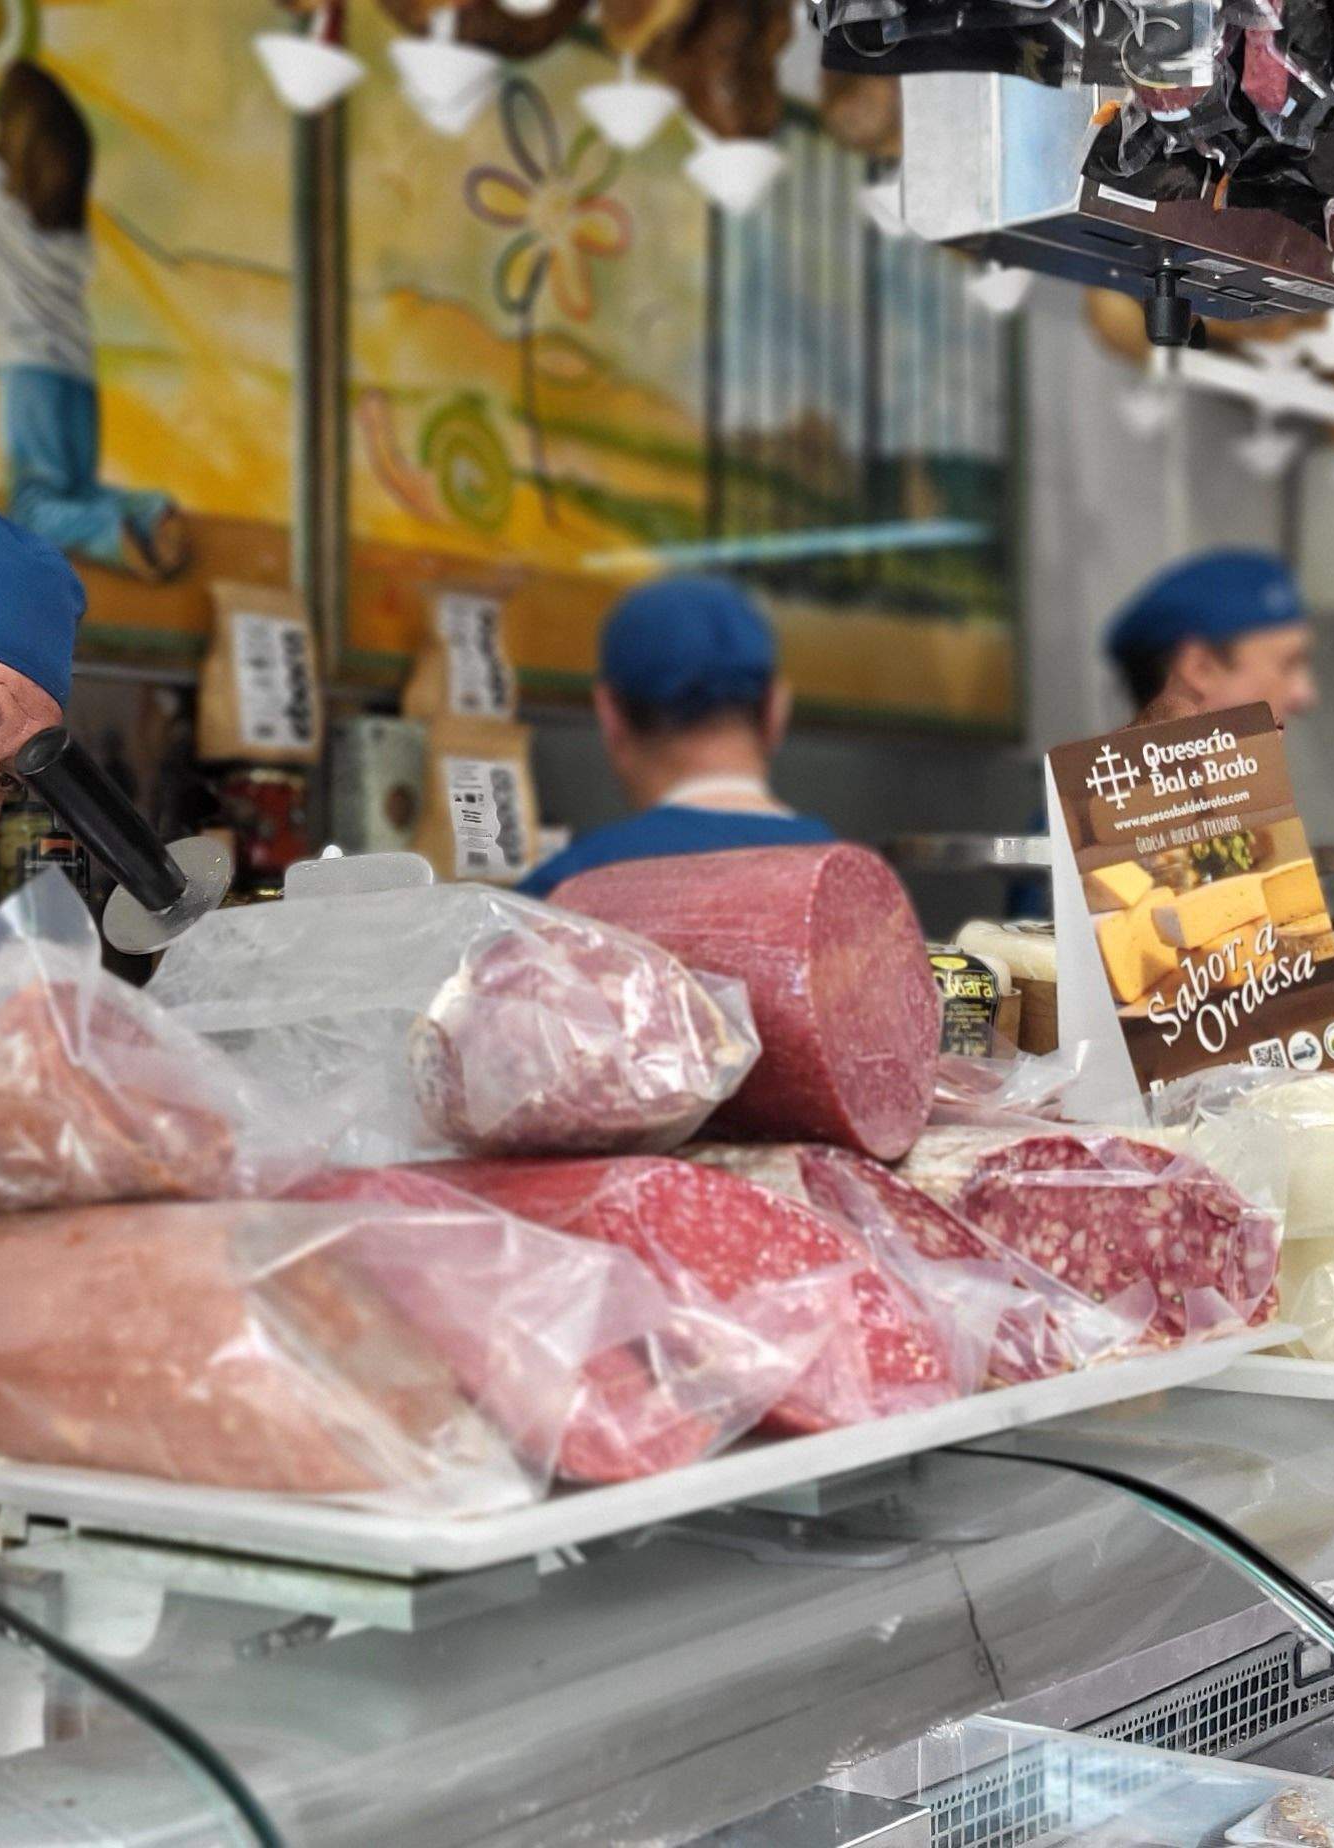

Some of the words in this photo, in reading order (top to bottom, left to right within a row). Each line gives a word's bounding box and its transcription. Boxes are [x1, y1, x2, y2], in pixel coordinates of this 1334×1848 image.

[1142, 728, 1237, 773] Quesería
[1149, 767, 1187, 797] Bal
[1188, 770, 1204, 788] de
[1202, 753, 1258, 785] Broto
[1114, 790, 1250, 831] www.quesosbaldebroto.com
[1147, 936, 1243, 1047] Sabor
[1255, 923, 1278, 956] a
[1196, 950, 1316, 1053] Ordesa
